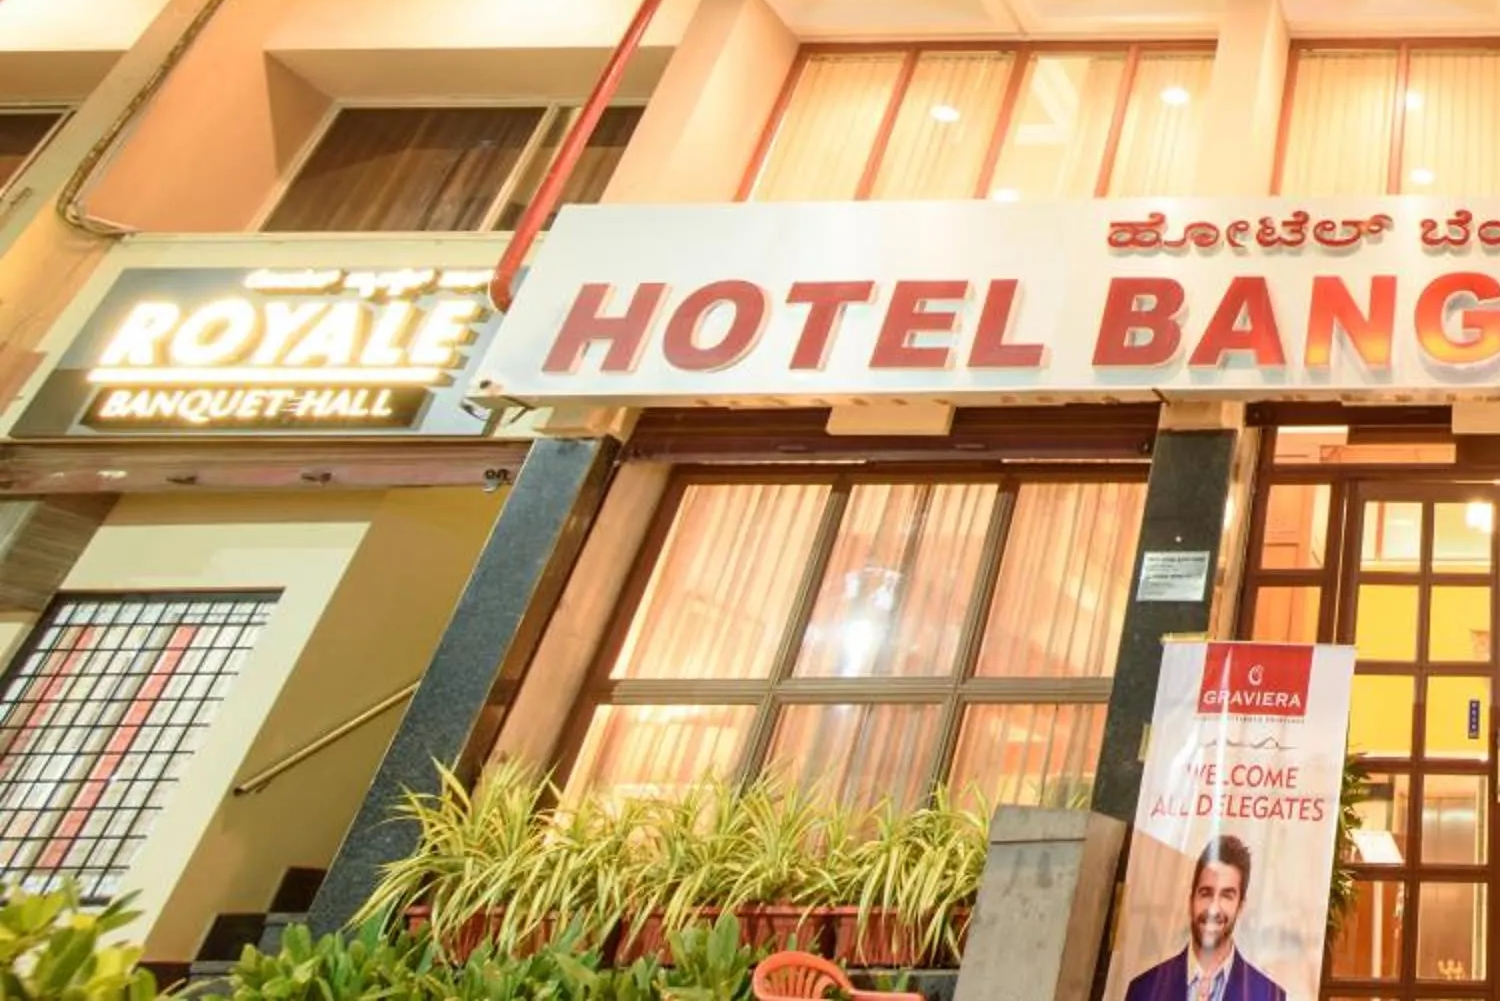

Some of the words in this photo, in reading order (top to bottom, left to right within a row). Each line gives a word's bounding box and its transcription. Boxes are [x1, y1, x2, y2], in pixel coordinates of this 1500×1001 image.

[1106, 209, 1395, 249] ಹೋಟೆಲ್
[98, 297, 480, 367] ROYALE
[541, 278, 1048, 373] HOTEL
[99, 387, 291, 424] BANQUET
[297, 387, 393, 417] HALL
[1203, 690, 1302, 708] GRAVIERA
[1186, 763, 1300, 789] WECOME
